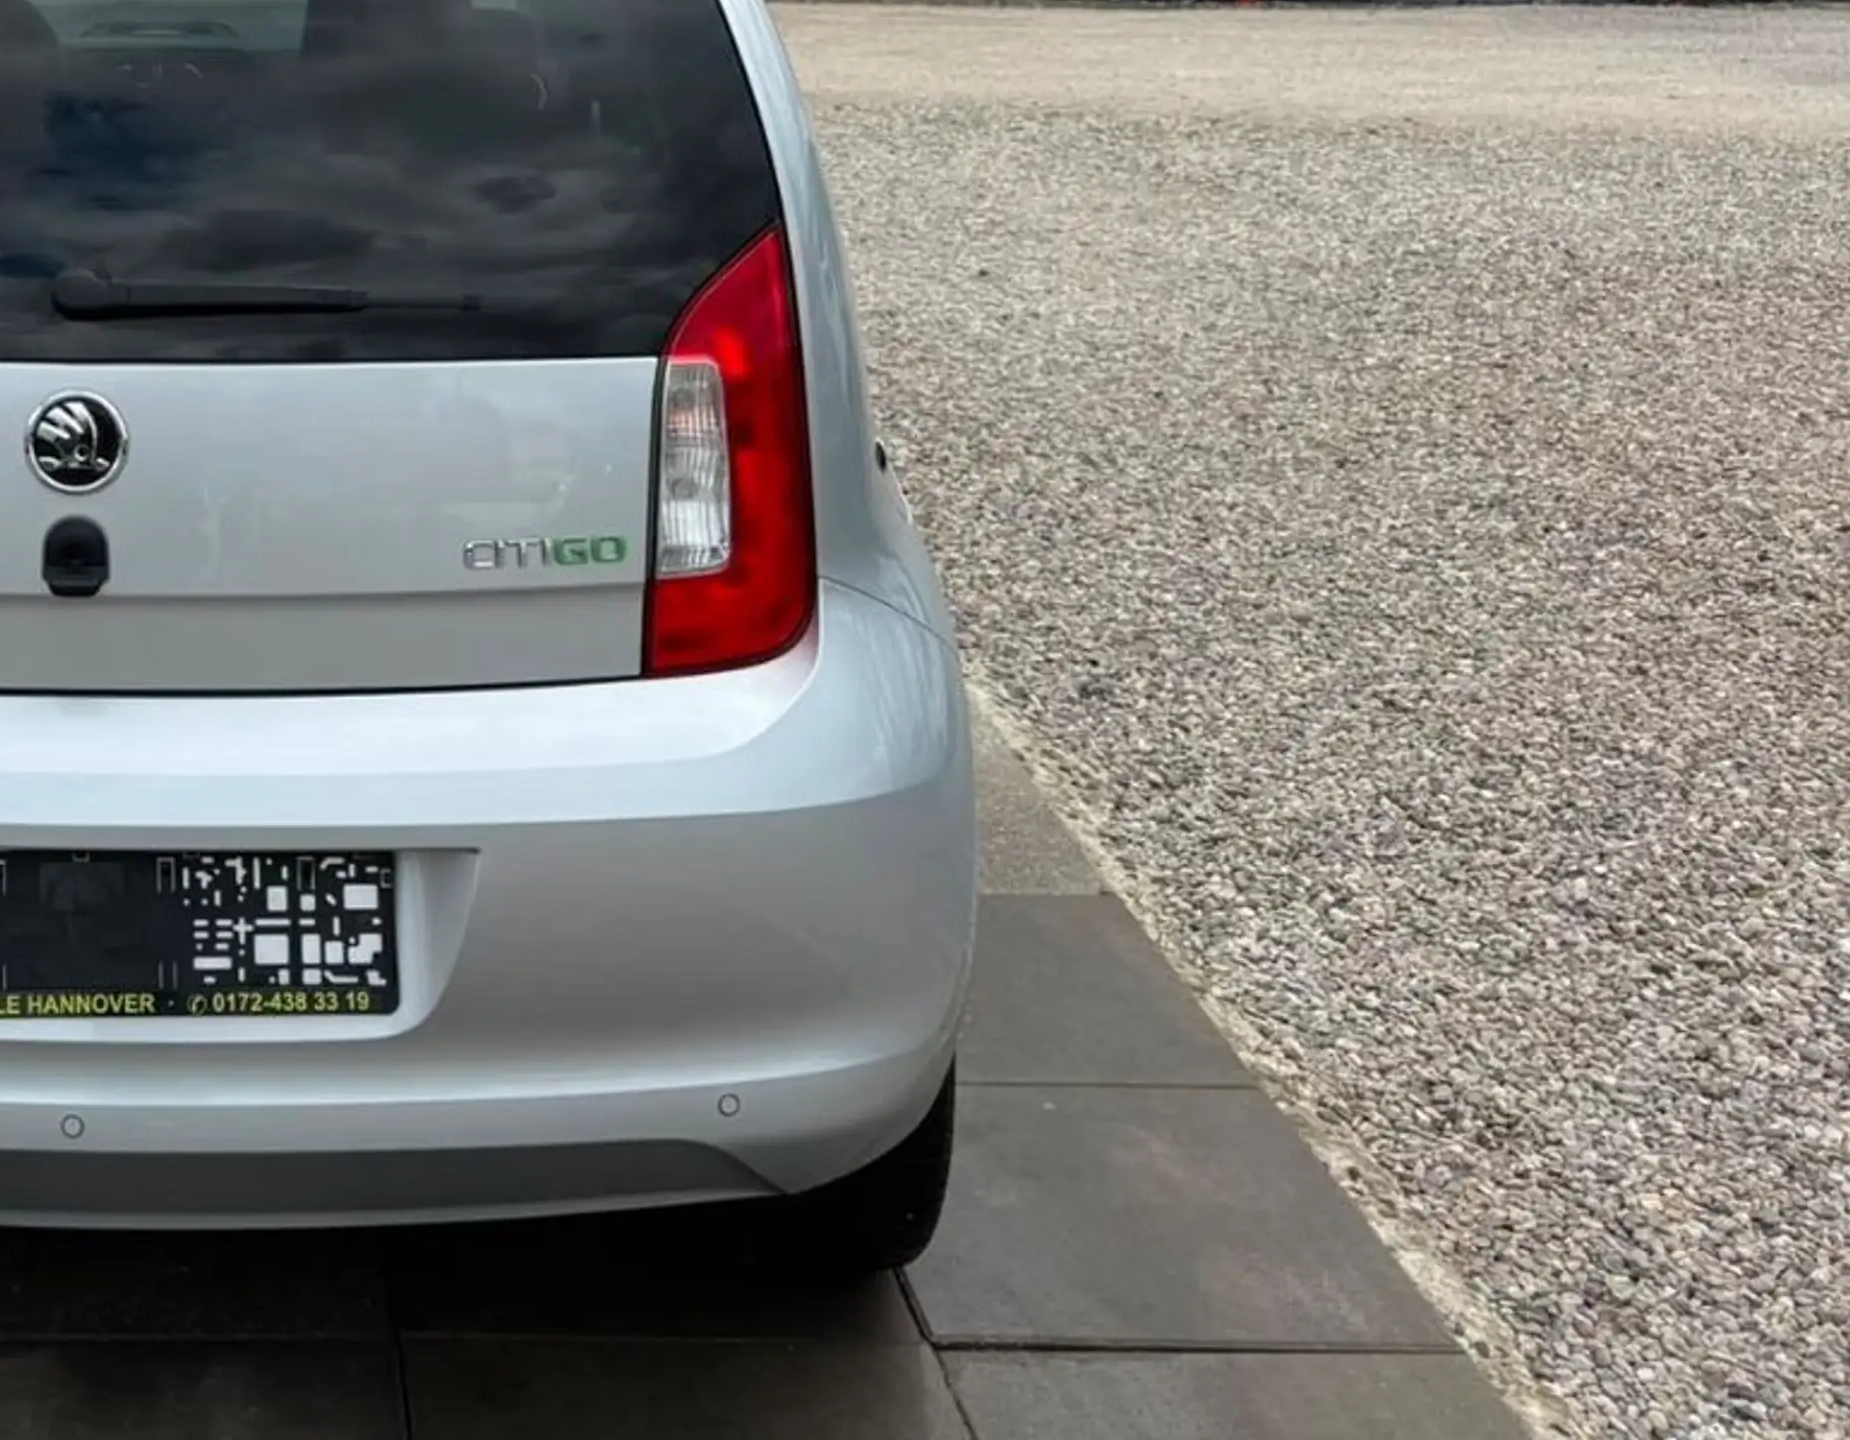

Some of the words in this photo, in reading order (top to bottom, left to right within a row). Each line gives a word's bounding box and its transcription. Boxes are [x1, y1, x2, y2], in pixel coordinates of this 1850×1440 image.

[463, 535, 628, 570] CITIGO
[27, 992, 156, 1014] HANNOVER
[212, 992, 308, 1012] 0172-438
[313, 991, 339, 1011] 33
[345, 991, 371, 1010] 19
